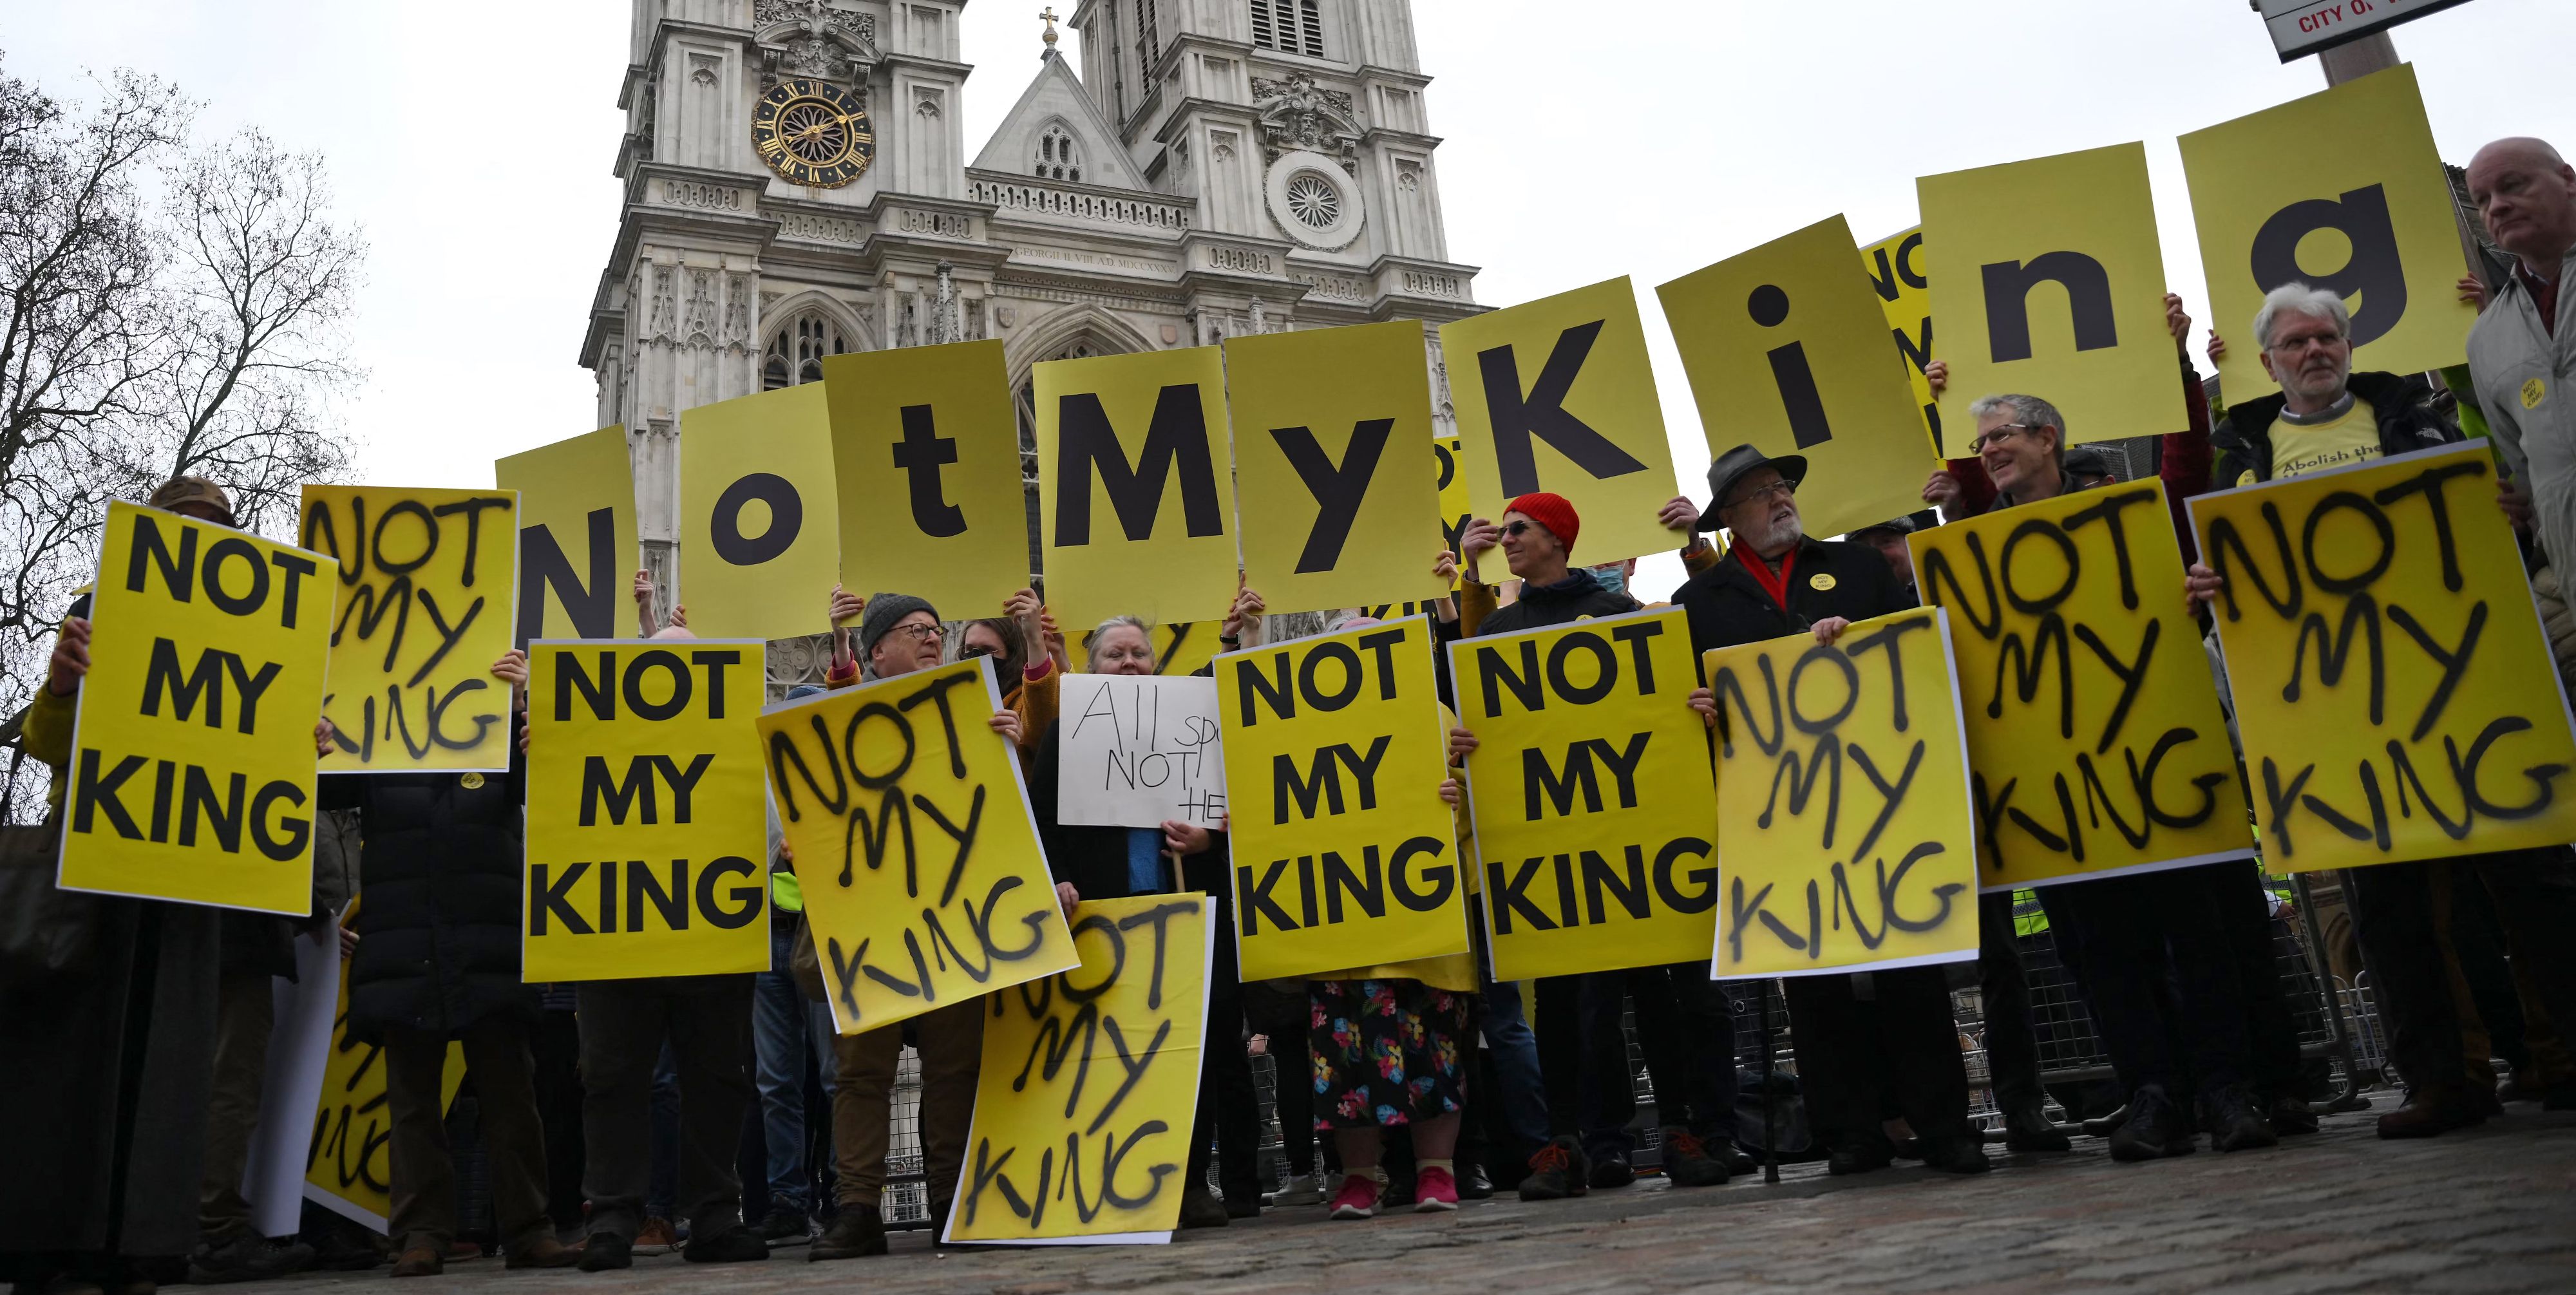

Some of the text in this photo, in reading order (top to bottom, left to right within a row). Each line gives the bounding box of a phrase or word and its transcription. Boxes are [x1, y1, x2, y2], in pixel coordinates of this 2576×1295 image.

[2298, 5, 2342, 33] CITY
[757, 118, 773, 129] IX
[764, 97, 781, 110] X
[783, 82, 799, 99] XI
[809, 81, 823, 97] XII
[835, 91, 845, 104] I
[849, 111, 866, 122] II
[856, 132, 871, 144] III
[761, 140, 781, 158] VIII
[780, 156, 797, 175] VII
[808, 166, 821, 183] VI
[835, 166, 847, 180] V
[1981, 250, 2117, 363] n
[2250, 182, 2407, 350] g
[1477, 319, 1649, 499] K
[1748, 284, 1832, 450] i
[892, 403, 968, 538] t
[1054, 383, 1224, 547] M
[1269, 417, 1396, 574] y
[2283, 444, 2382, 474] Abolish the
[127, 514, 316, 630] NOT
[305, 496, 512, 587] NOT
[516, 506, 616, 639] N
[1924, 488, 2156, 639] NOT
[2208, 461, 2486, 622] NOT
[332, 575, 484, 688] MY
[1236, 629, 1405, 727] NOT
[1477, 621, 1663, 718] NOT
[2282, 591, 2487, 744] MY
[140, 638, 283, 735] MY
[554, 650, 741, 721] NOT
[1072, 681, 1158, 757] All
[1715, 616, 1930, 758] NOT
[1987, 612, 2159, 754] MY
[578, 753, 715, 827] MY
[772, 670, 977, 822] NOT
[1106, 750, 1197, 791] NOT
[1273, 735, 1392, 825] MY
[1522, 732, 1652, 821] MY
[2262, 716, 2568, 857] KING
[73, 748, 310, 862] KING
[838, 784, 986, 907] MY
[1758, 732, 1924, 864] MY
[1975, 728, 2228, 868] KING
[530, 856, 763, 936] KING
[1237, 836, 1454, 937] KING
[1487, 837, 1718, 935] KING
[1731, 842, 1965, 963] KING
[828, 876, 1051, 1019] KING
[1012, 1002, 1170, 1136] MY
[966, 1121, 1179, 1229] KING
